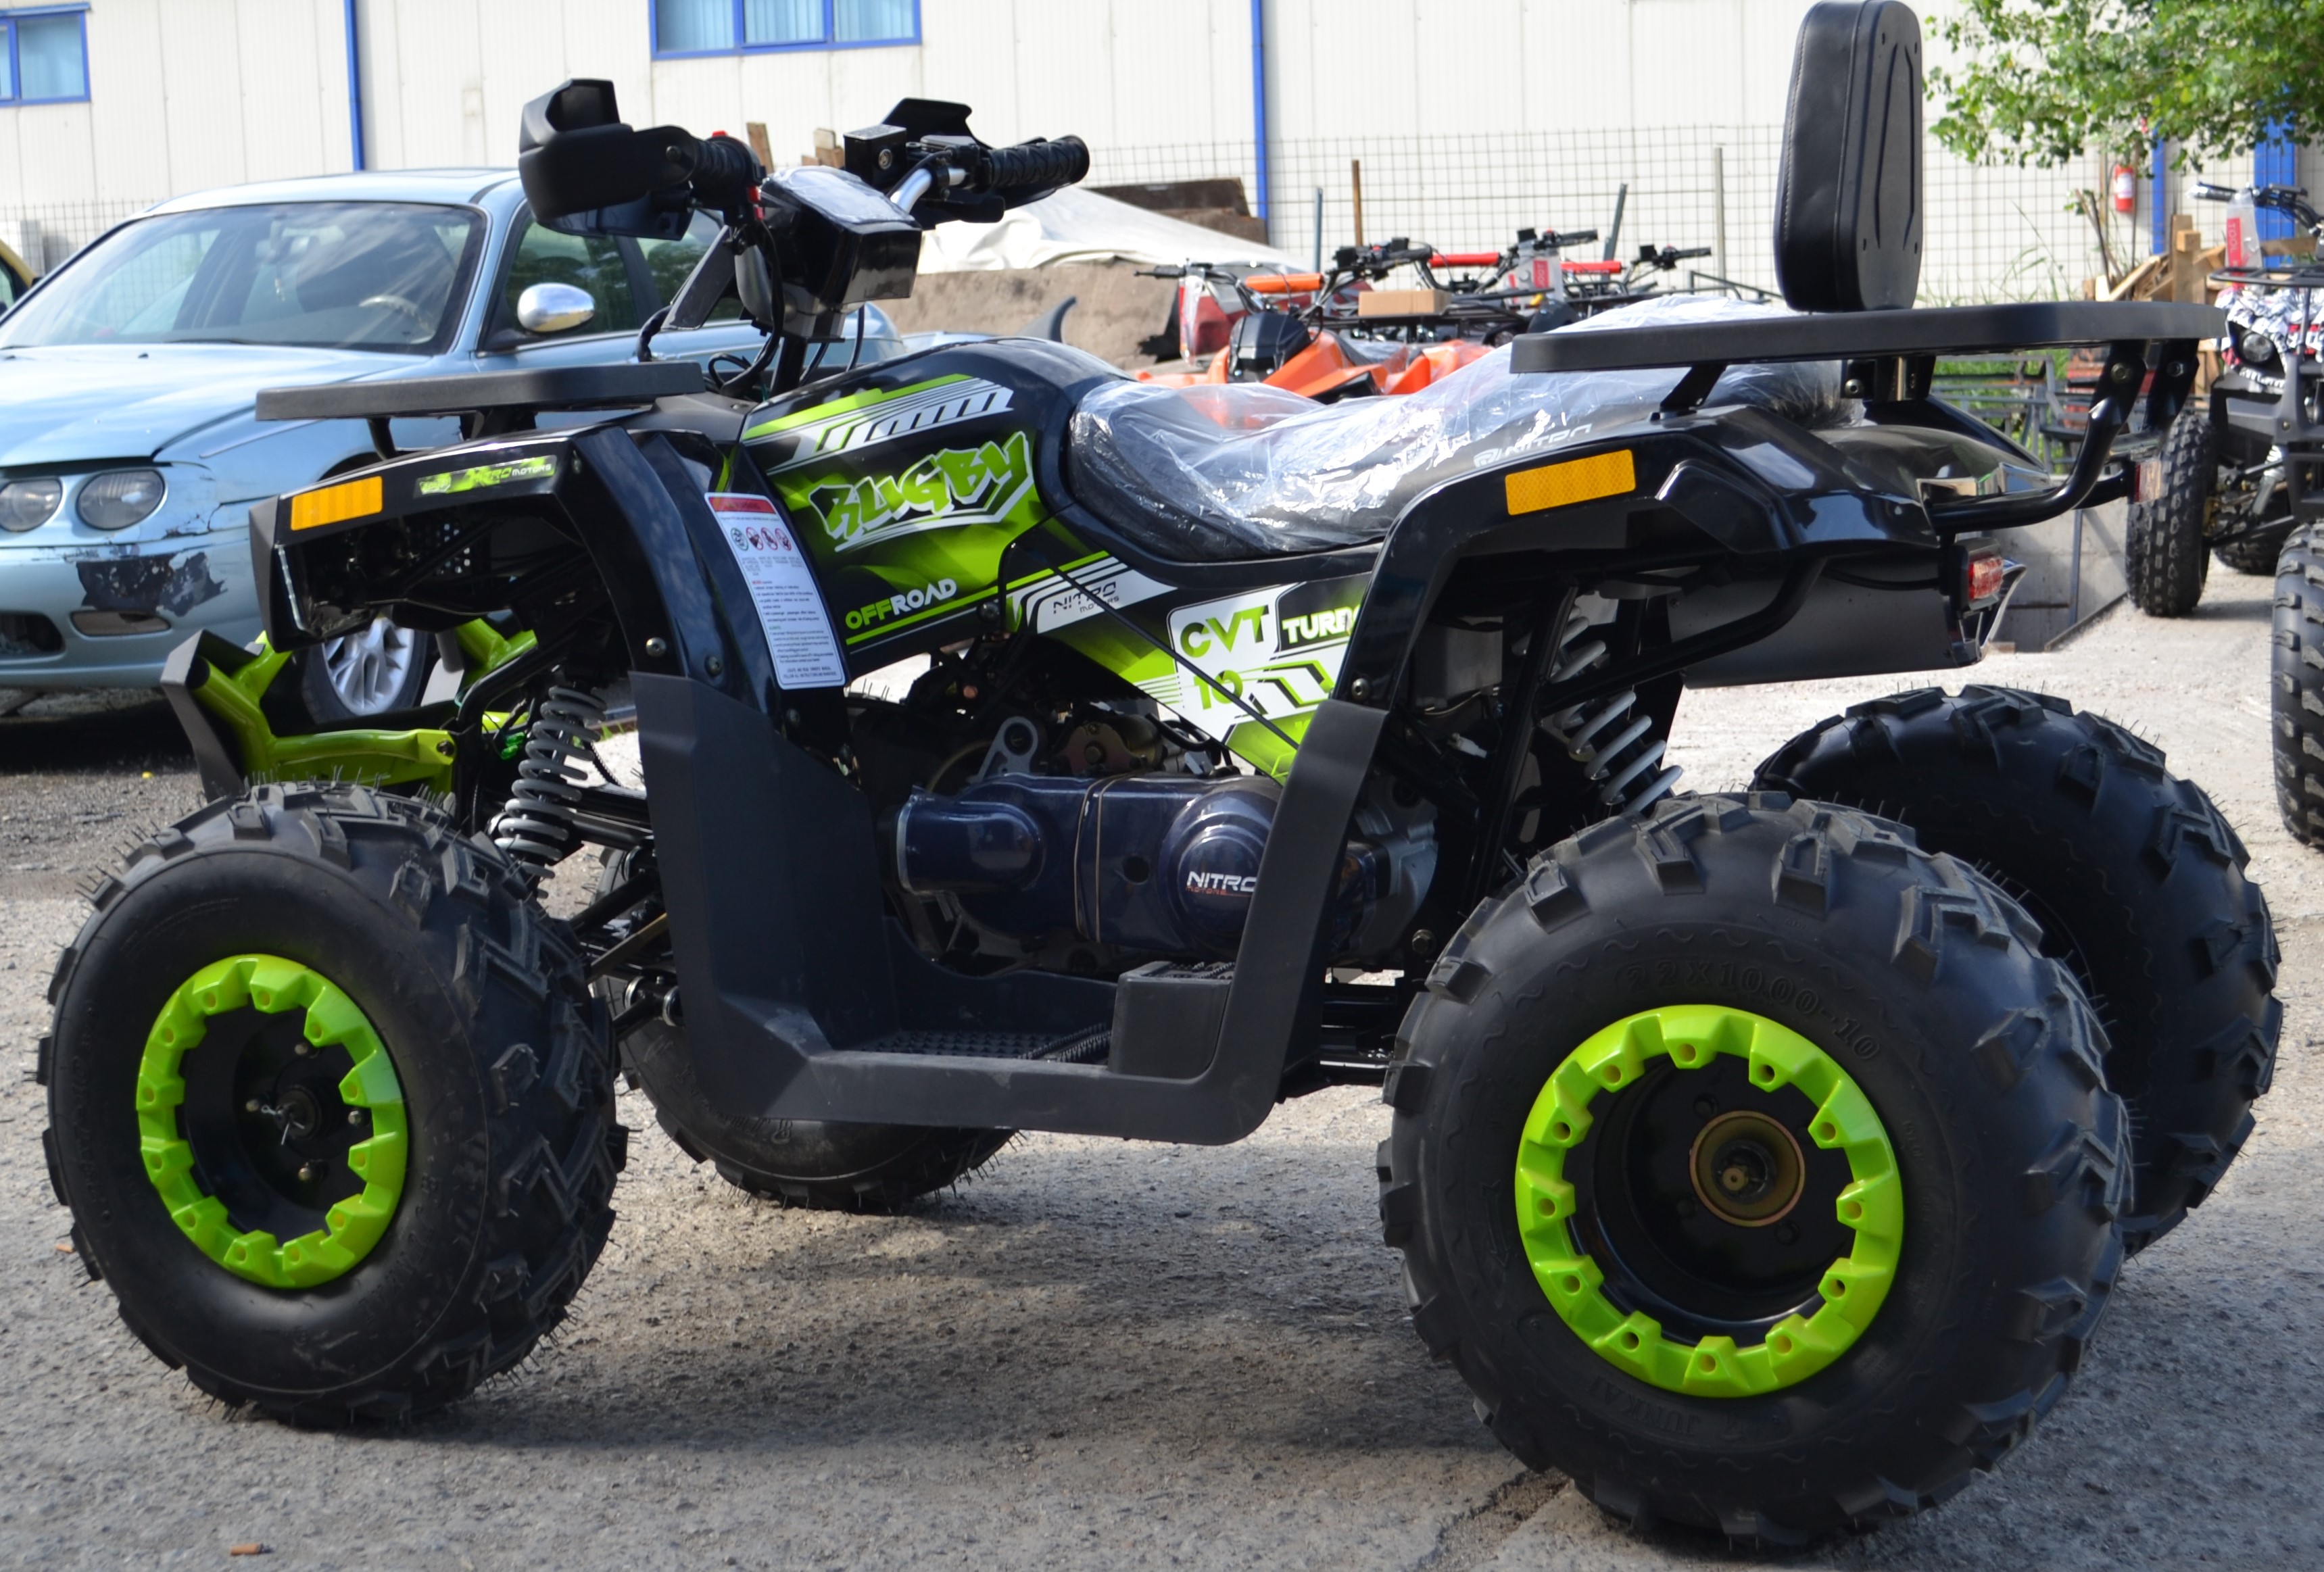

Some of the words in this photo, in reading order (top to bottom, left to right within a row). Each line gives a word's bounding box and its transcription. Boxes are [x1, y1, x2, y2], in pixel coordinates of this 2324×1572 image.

[512, 464, 552, 476] MOTORS
[808, 431, 1034, 542] RUGBY
[846, 578, 957, 630] OFFROAD
[1080, 595, 1119, 613] MORS
[1180, 604, 1269, 658] CVT
[1186, 870, 1257, 893] NITRO
